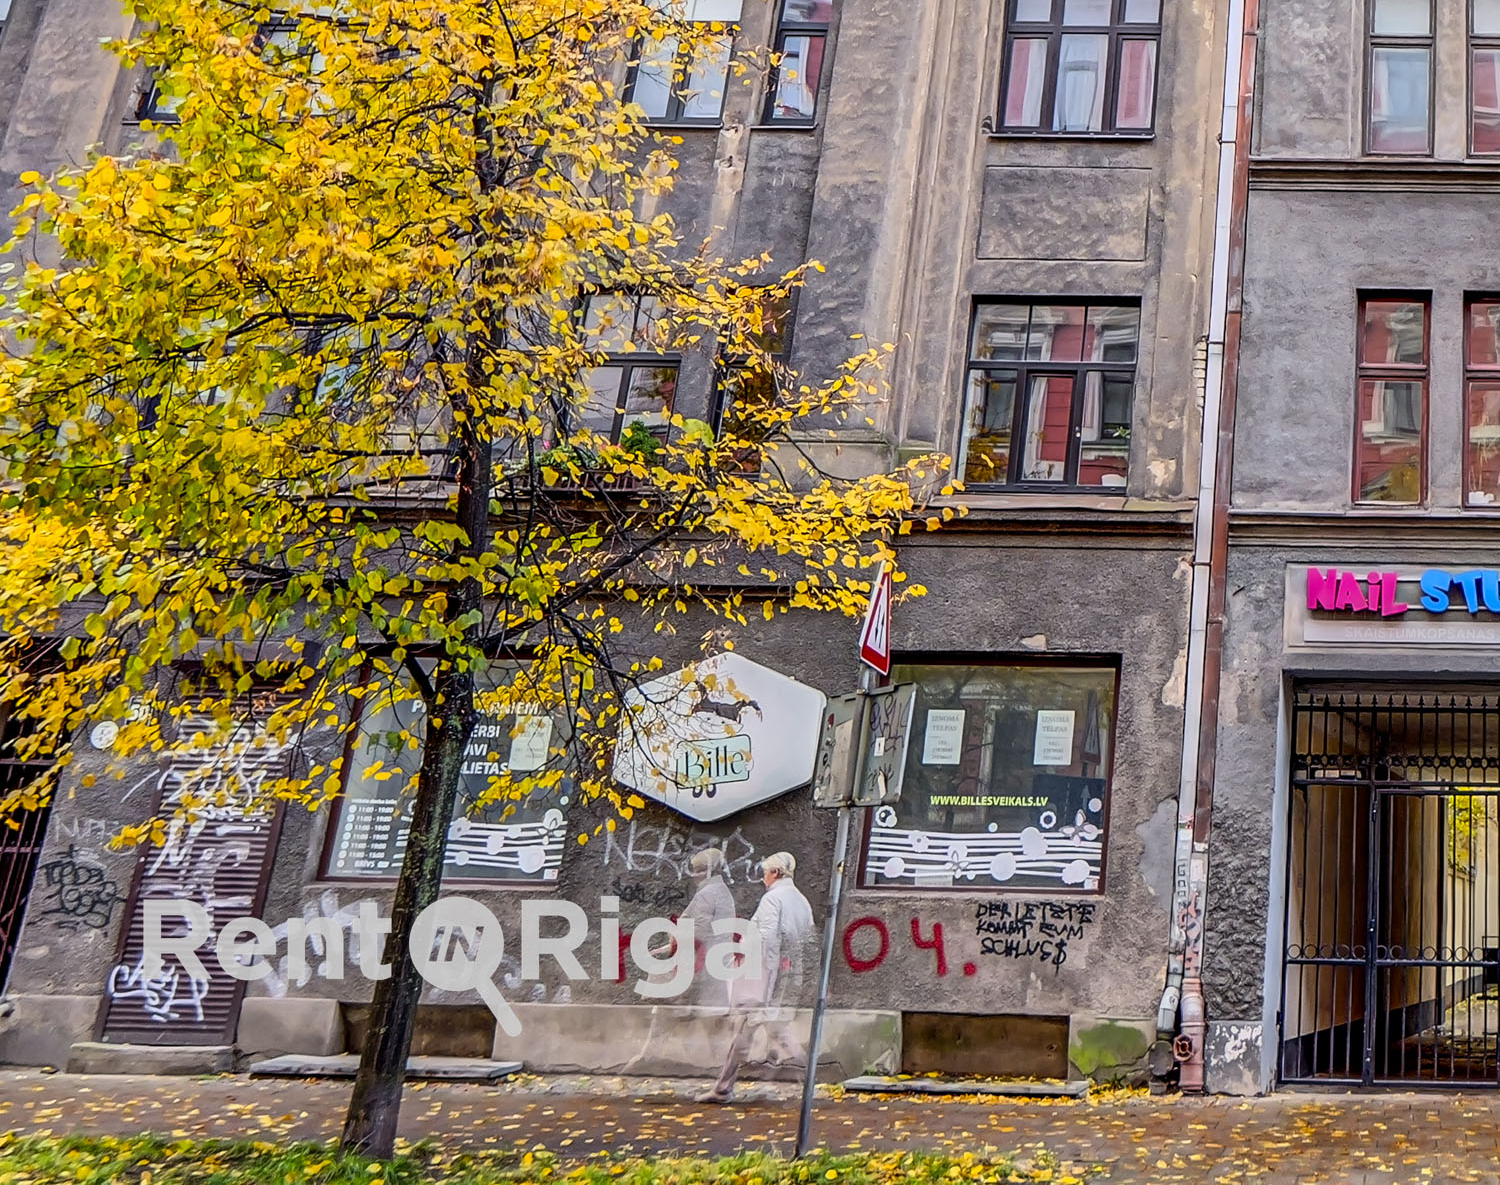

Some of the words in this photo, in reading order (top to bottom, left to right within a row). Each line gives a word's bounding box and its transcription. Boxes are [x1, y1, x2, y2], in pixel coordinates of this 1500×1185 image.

[463, 743, 488, 756] AVI
[460, 761, 509, 775] LIETAS
[684, 745, 745, 781] Bille
[930, 795, 1049, 807] WWW.BILLESVEIKALS.LV
